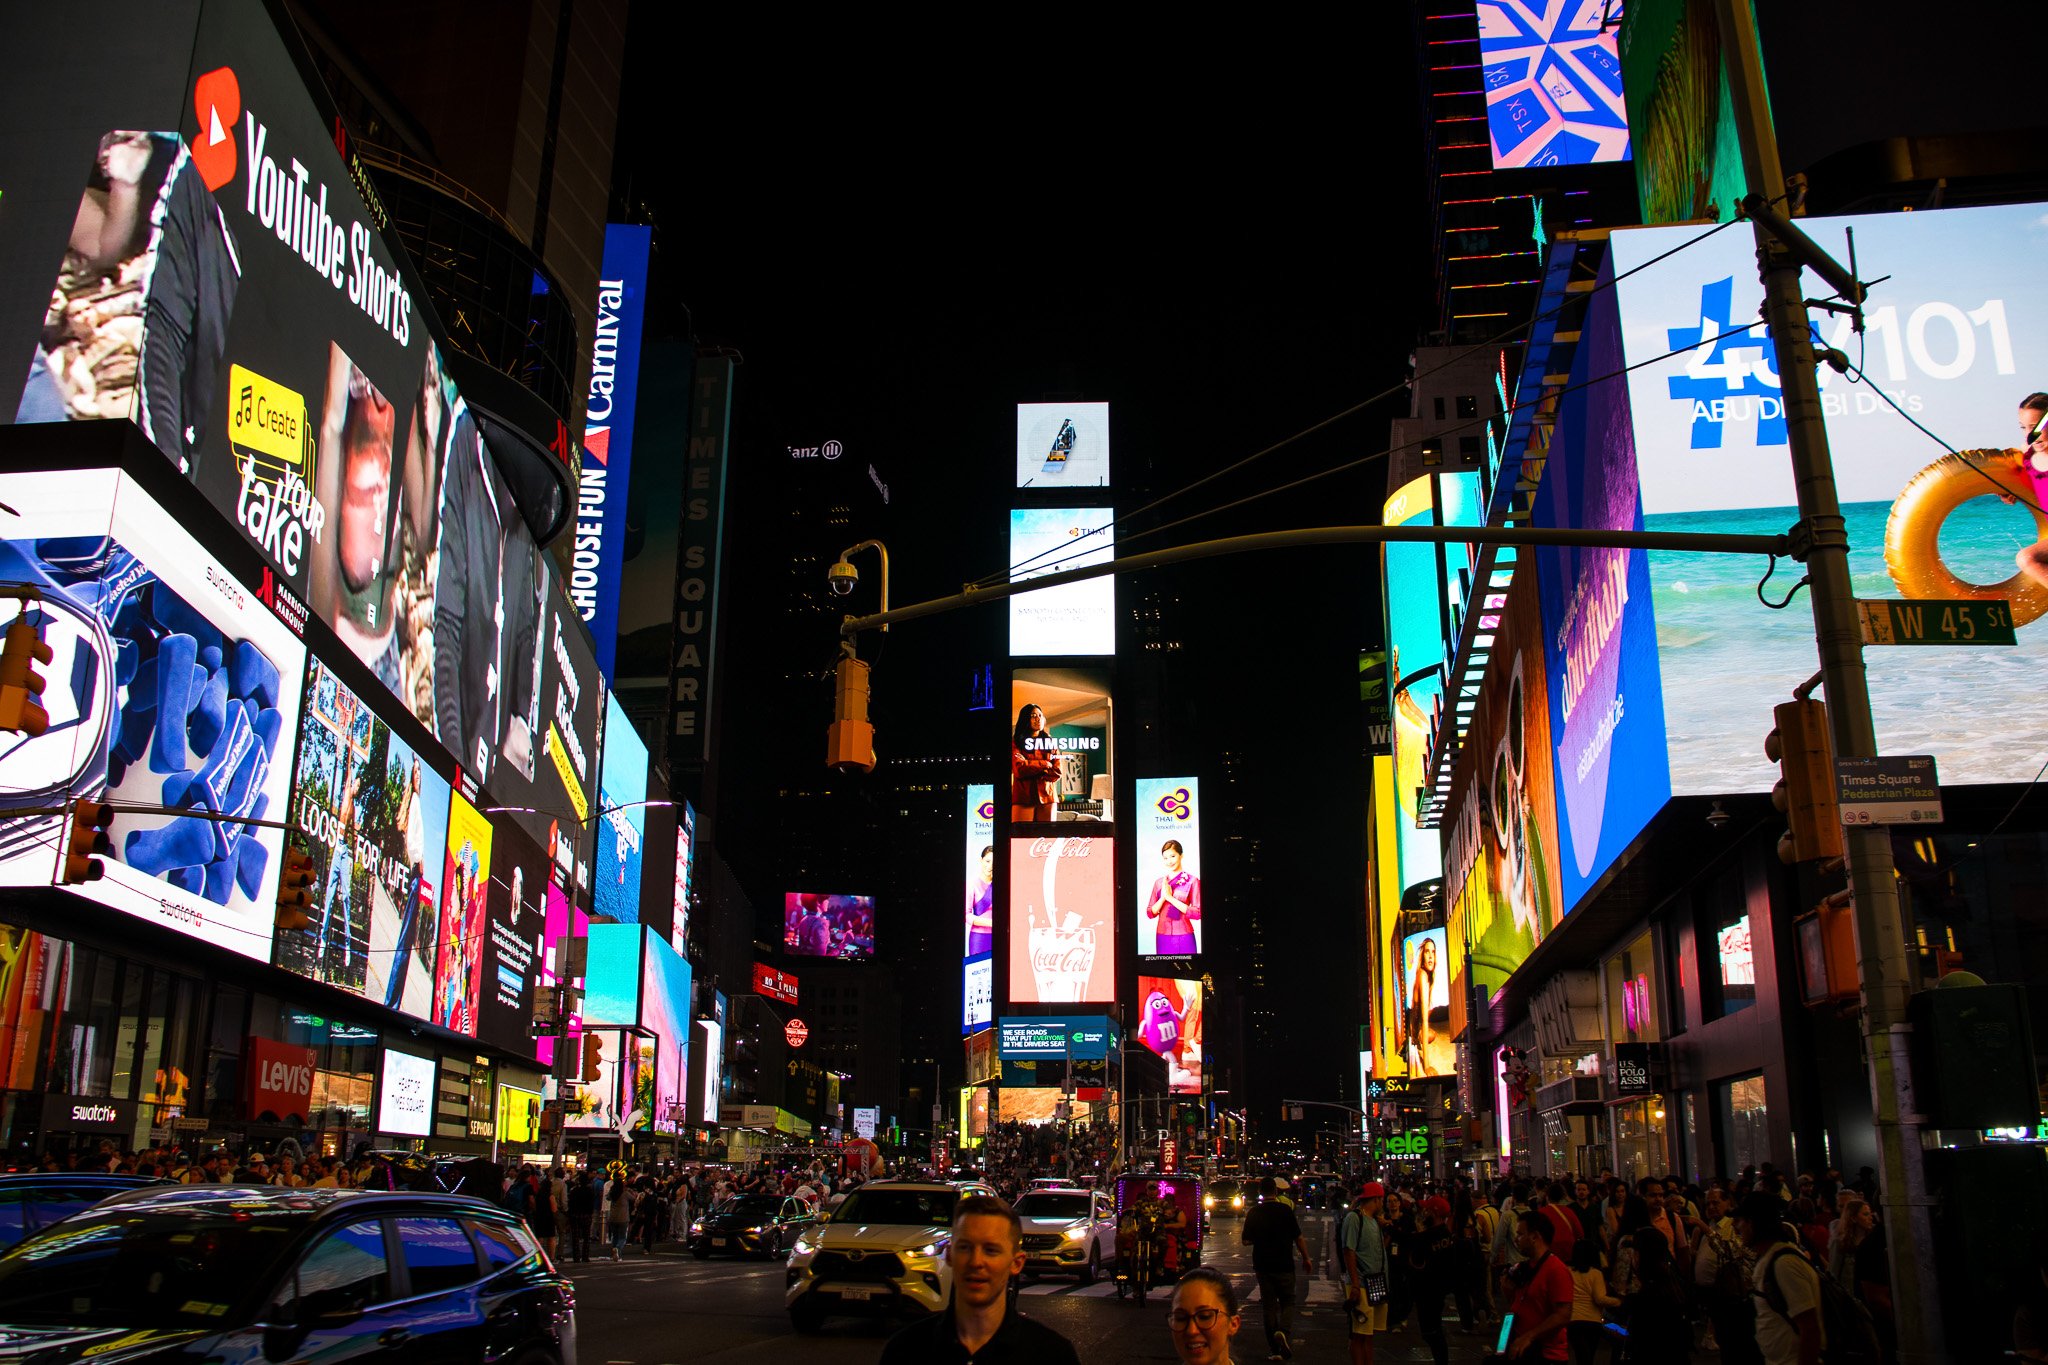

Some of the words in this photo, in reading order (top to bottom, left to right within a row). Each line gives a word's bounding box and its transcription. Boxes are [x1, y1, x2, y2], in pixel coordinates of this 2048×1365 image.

[352, 153, 388, 229] MARRIOTT
[246, 110, 346, 290] YouTube
[349, 221, 411, 348] Shorts
[586, 279, 624, 421] Carnival
[257, 396, 297, 440] Create
[1691, 396, 1752, 424] ABU
[1759, 388, 1849, 420] DBI
[1857, 390, 1923, 415] DO's
[689, 377, 718, 521] TIMES
[283, 462, 325, 545] YOUR
[577, 468, 607, 518] FUN
[237, 453, 303, 577] take
[1081, 528, 1106, 537] THAI
[570, 523, 603, 622] CHOOSE
[275, 599, 305, 634] MARQUIS
[277, 583, 310, 622] MARRIOTT
[675, 545, 707, 736] SQUARE
[1896, 606, 1924, 639] W
[1941, 606, 1976, 640] 45
[1987, 607, 2007, 627] St
[1024, 737, 1100, 750] SAMSUNG
[1840, 774, 1876, 786] Times
[1878, 774, 1921, 787] Square
[1842, 788, 1902, 799] Pedestrian
[1903, 787, 1935, 798] Plaza
[301, 801, 345, 848] LOOSE
[354, 834, 379, 874] FOR
[388, 854, 410, 895] LIFE
[159, 898, 197, 924] swatch
[1033, 947, 1092, 972] Coca-Cola
[260, 1059, 311, 1096] Levi's
[1619, 1060, 1637, 1068] U.S.
[1620, 1068, 1646, 1077] POLO
[1620, 1077, 1649, 1085] ASSN.
[72, 1105, 110, 1122] swatch
[470, 1120, 494, 1137] SEPHORA
[1164, 1140, 1175, 1164] tkts
